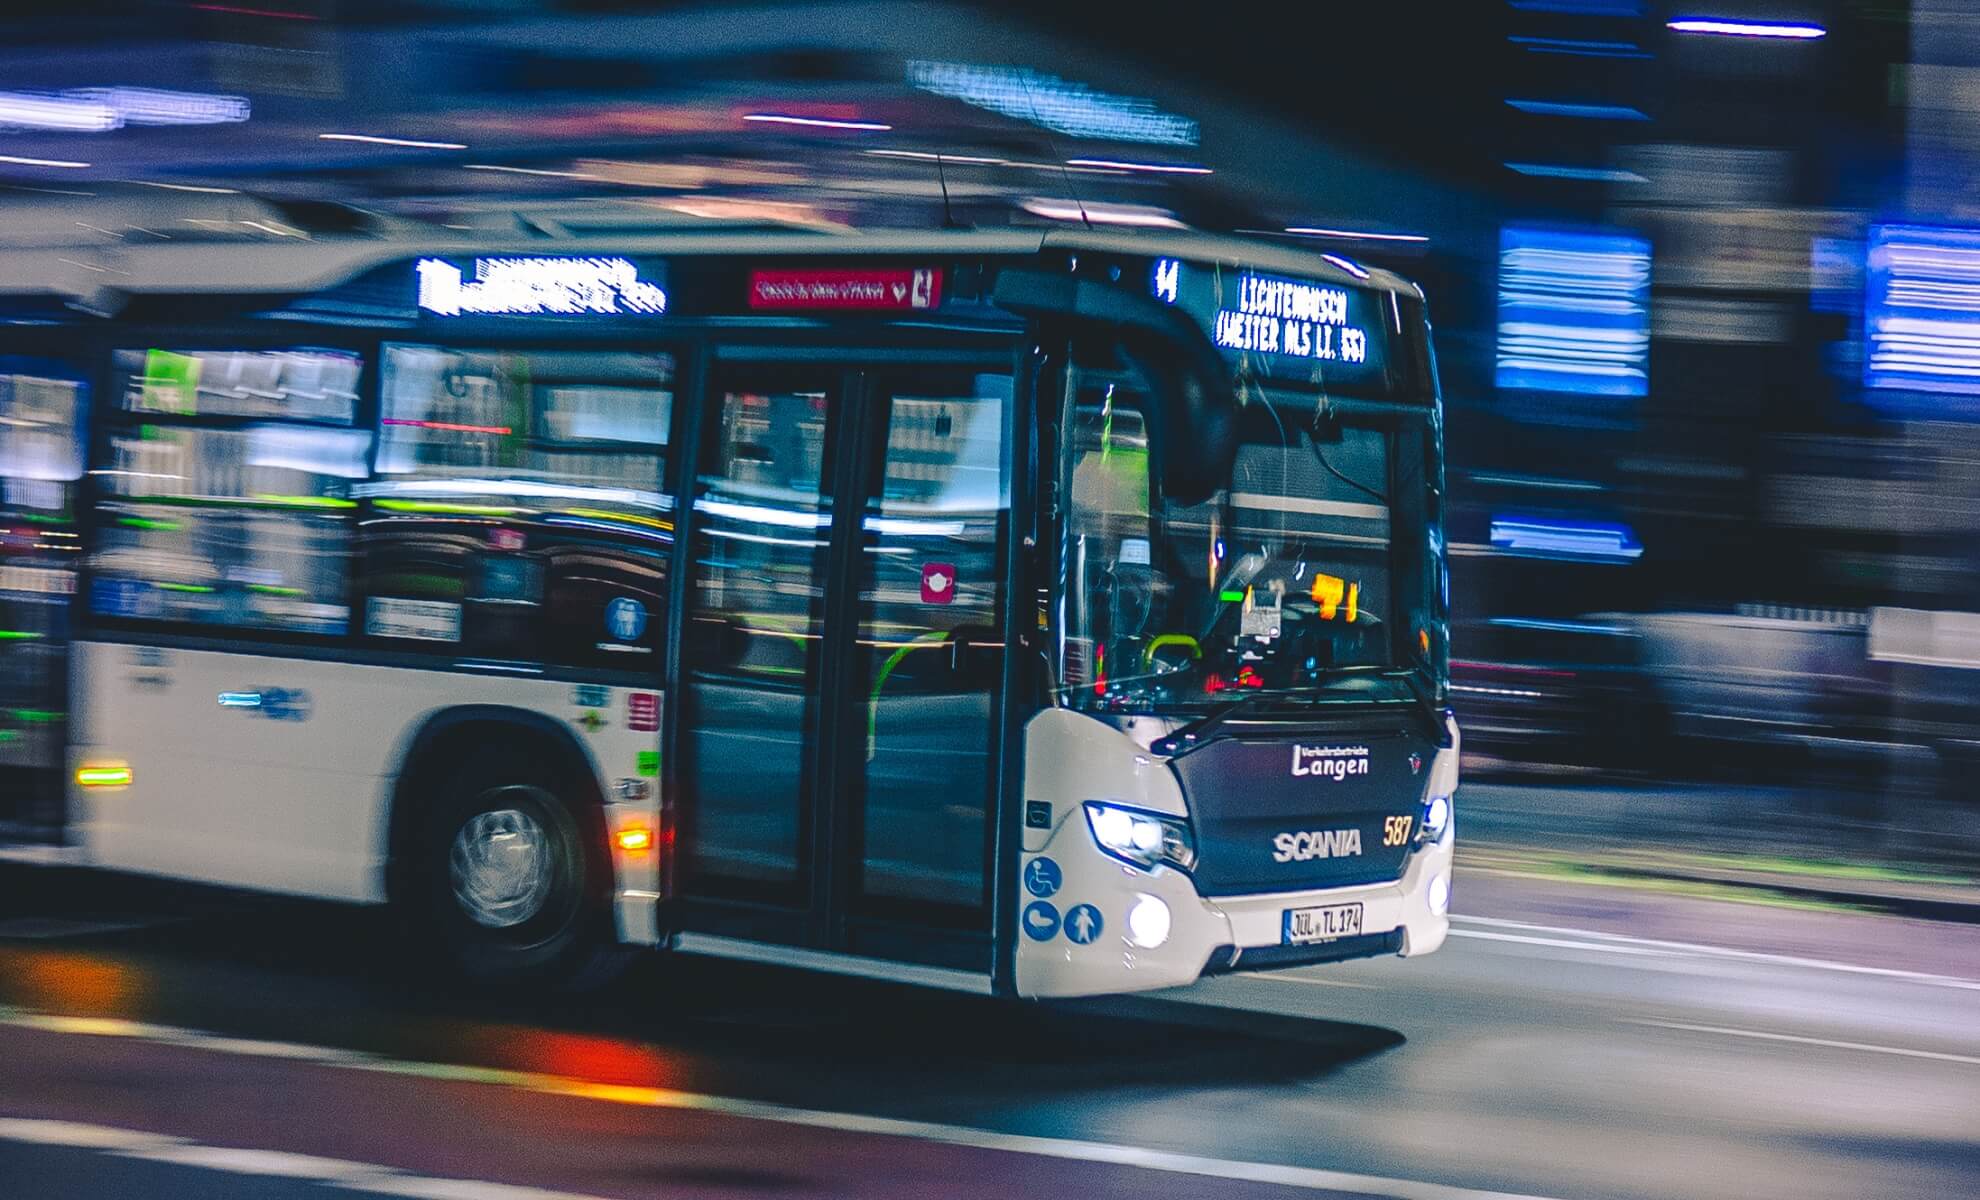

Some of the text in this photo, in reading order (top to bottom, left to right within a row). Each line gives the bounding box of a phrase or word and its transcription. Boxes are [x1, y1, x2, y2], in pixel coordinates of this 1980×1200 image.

[1291, 744, 1368, 781] Langen
[1272, 829, 1362, 863] SCANIA
[1383, 815, 1412, 847] 587
[1323, 911, 1336, 934] TL
